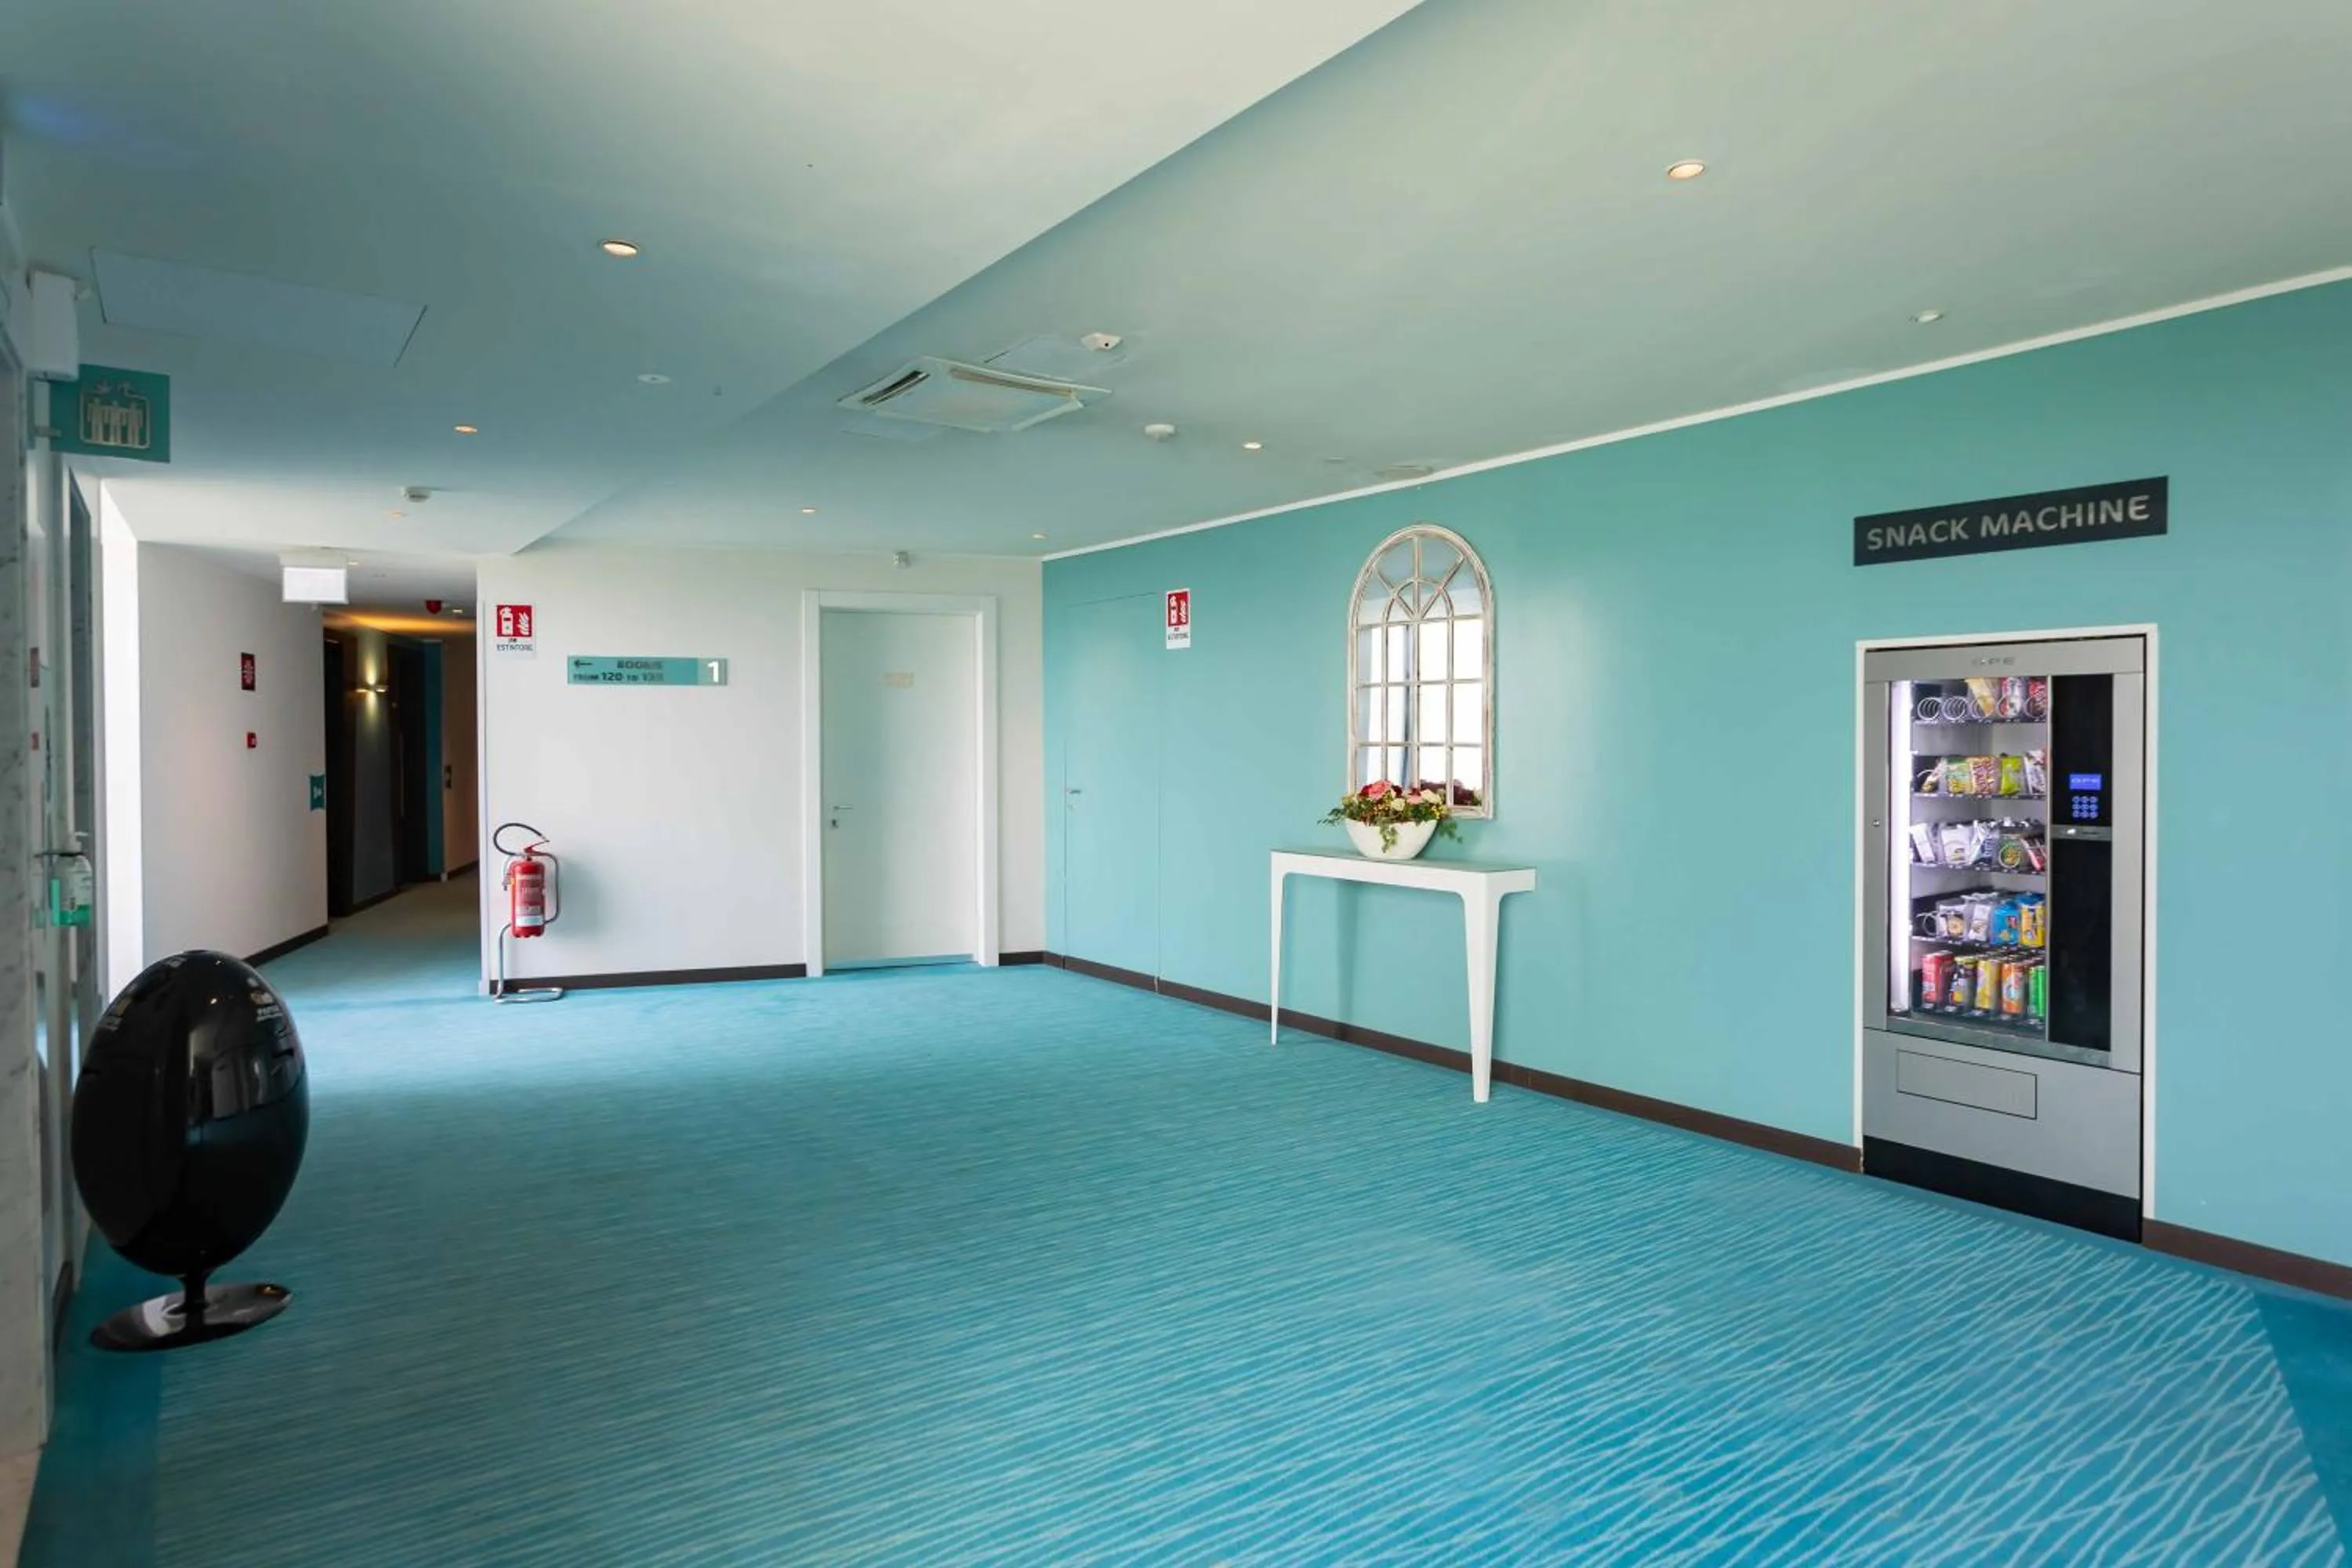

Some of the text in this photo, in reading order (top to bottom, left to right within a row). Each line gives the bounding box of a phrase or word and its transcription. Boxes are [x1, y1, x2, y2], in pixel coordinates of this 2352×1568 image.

[1867, 494, 2150, 550] SNACK MACHINE
[601, 672, 623, 681] 120
[706, 661, 720, 683] 1
